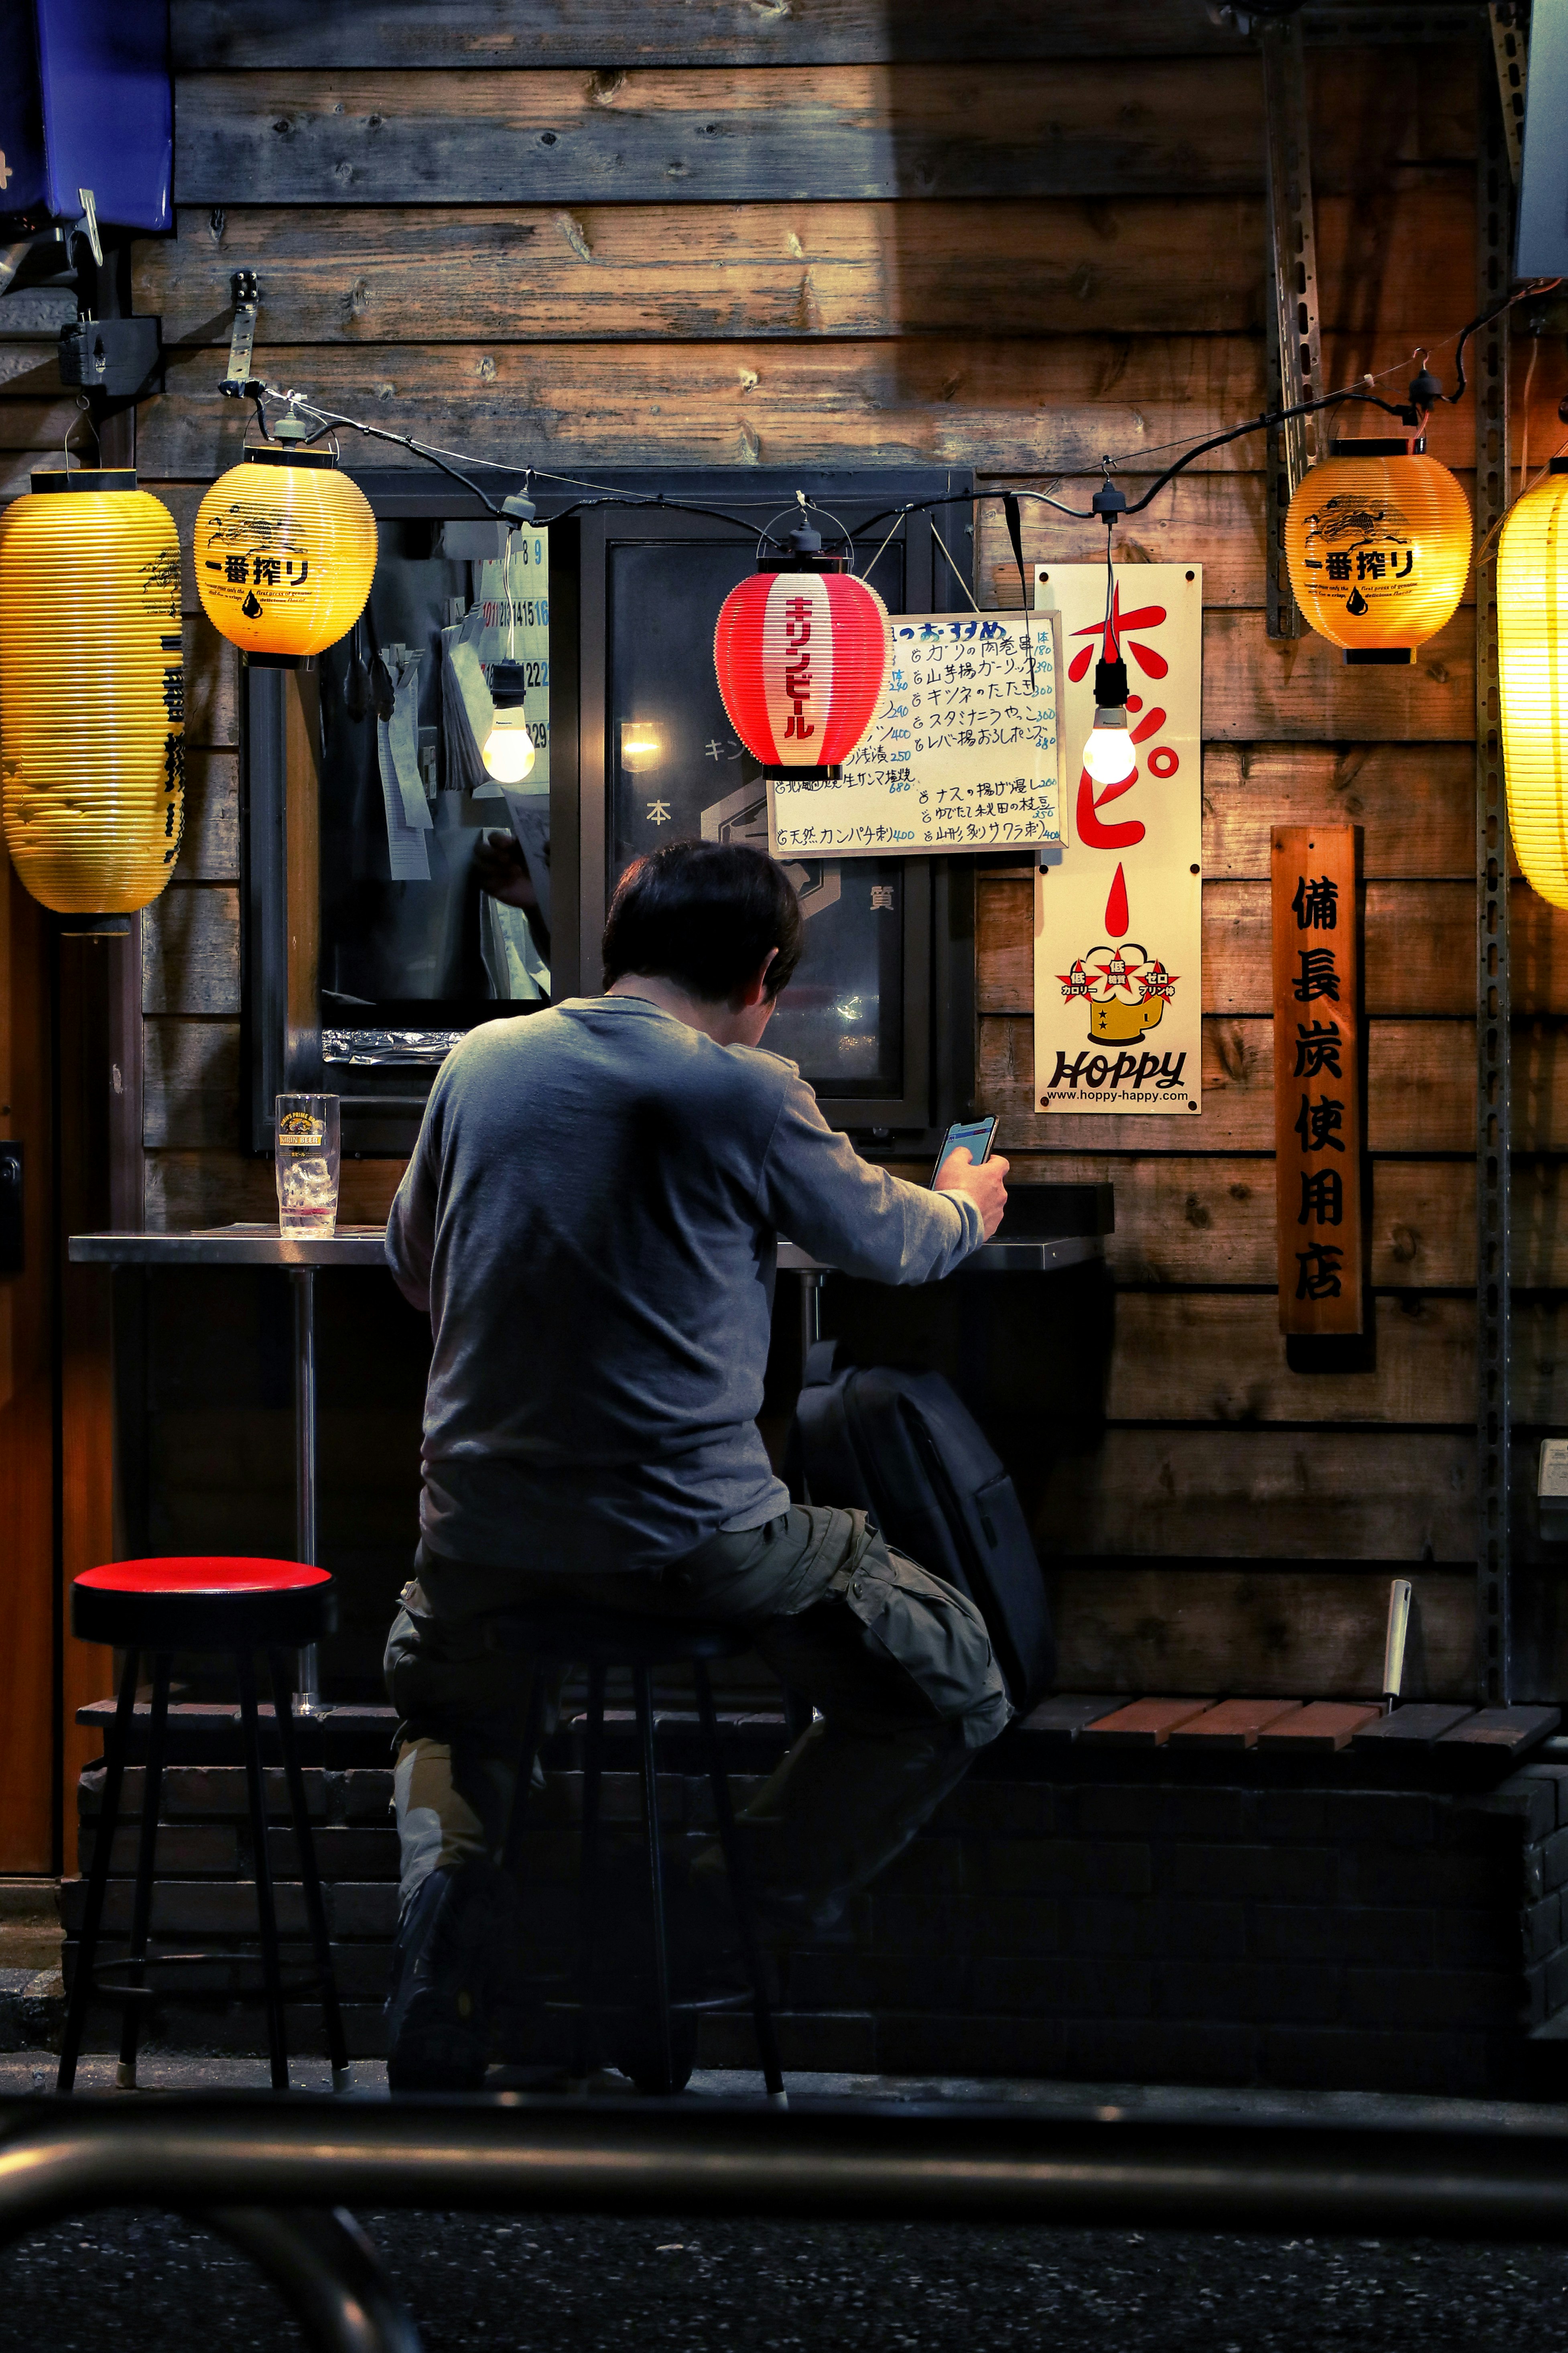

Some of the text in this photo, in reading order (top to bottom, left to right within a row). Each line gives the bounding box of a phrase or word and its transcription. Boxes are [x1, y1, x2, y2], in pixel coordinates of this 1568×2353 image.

[535, 539, 541, 565] 9
[205, 555, 308, 586] 一番搾り
[1305, 551, 1413, 580] 一番搾り
[522, 601, 534, 626] 15
[534, 600, 549, 626] 16
[892, 621, 1007, 643] のおすすめ
[527, 663, 540, 687] 22
[541, 661, 549, 686] 2
[784, 597, 814, 739] キリンビール
[1035, 661, 1053, 674] 390
[1032, 685, 1052, 698] 300
[887, 705, 909, 718] 290
[1036, 708, 1056, 722] 300
[532, 723, 546, 748] 29
[891, 727, 911, 741] 400
[705, 739, 754, 761] キン
[846, 744, 911, 766] 浅漬 250
[889, 783, 911, 793] 680
[646, 799, 671, 825] 本
[893, 830, 915, 842] 400
[1044, 830, 1060, 840] 400
[870, 886, 894, 911] 質
[1109, 960, 1125, 974] 低
[1070, 972, 1086, 985] 低
[1108, 975, 1126, 985] 糖質
[1146, 972, 1169, 984] ゼロ
[1062, 985, 1097, 995] カロリー
[1139, 986, 1175, 996] プリン体
[1292, 875, 1346, 1300] 備長炭使用店
[1047, 1090, 1188, 1102] www.hoppy-happy.com
